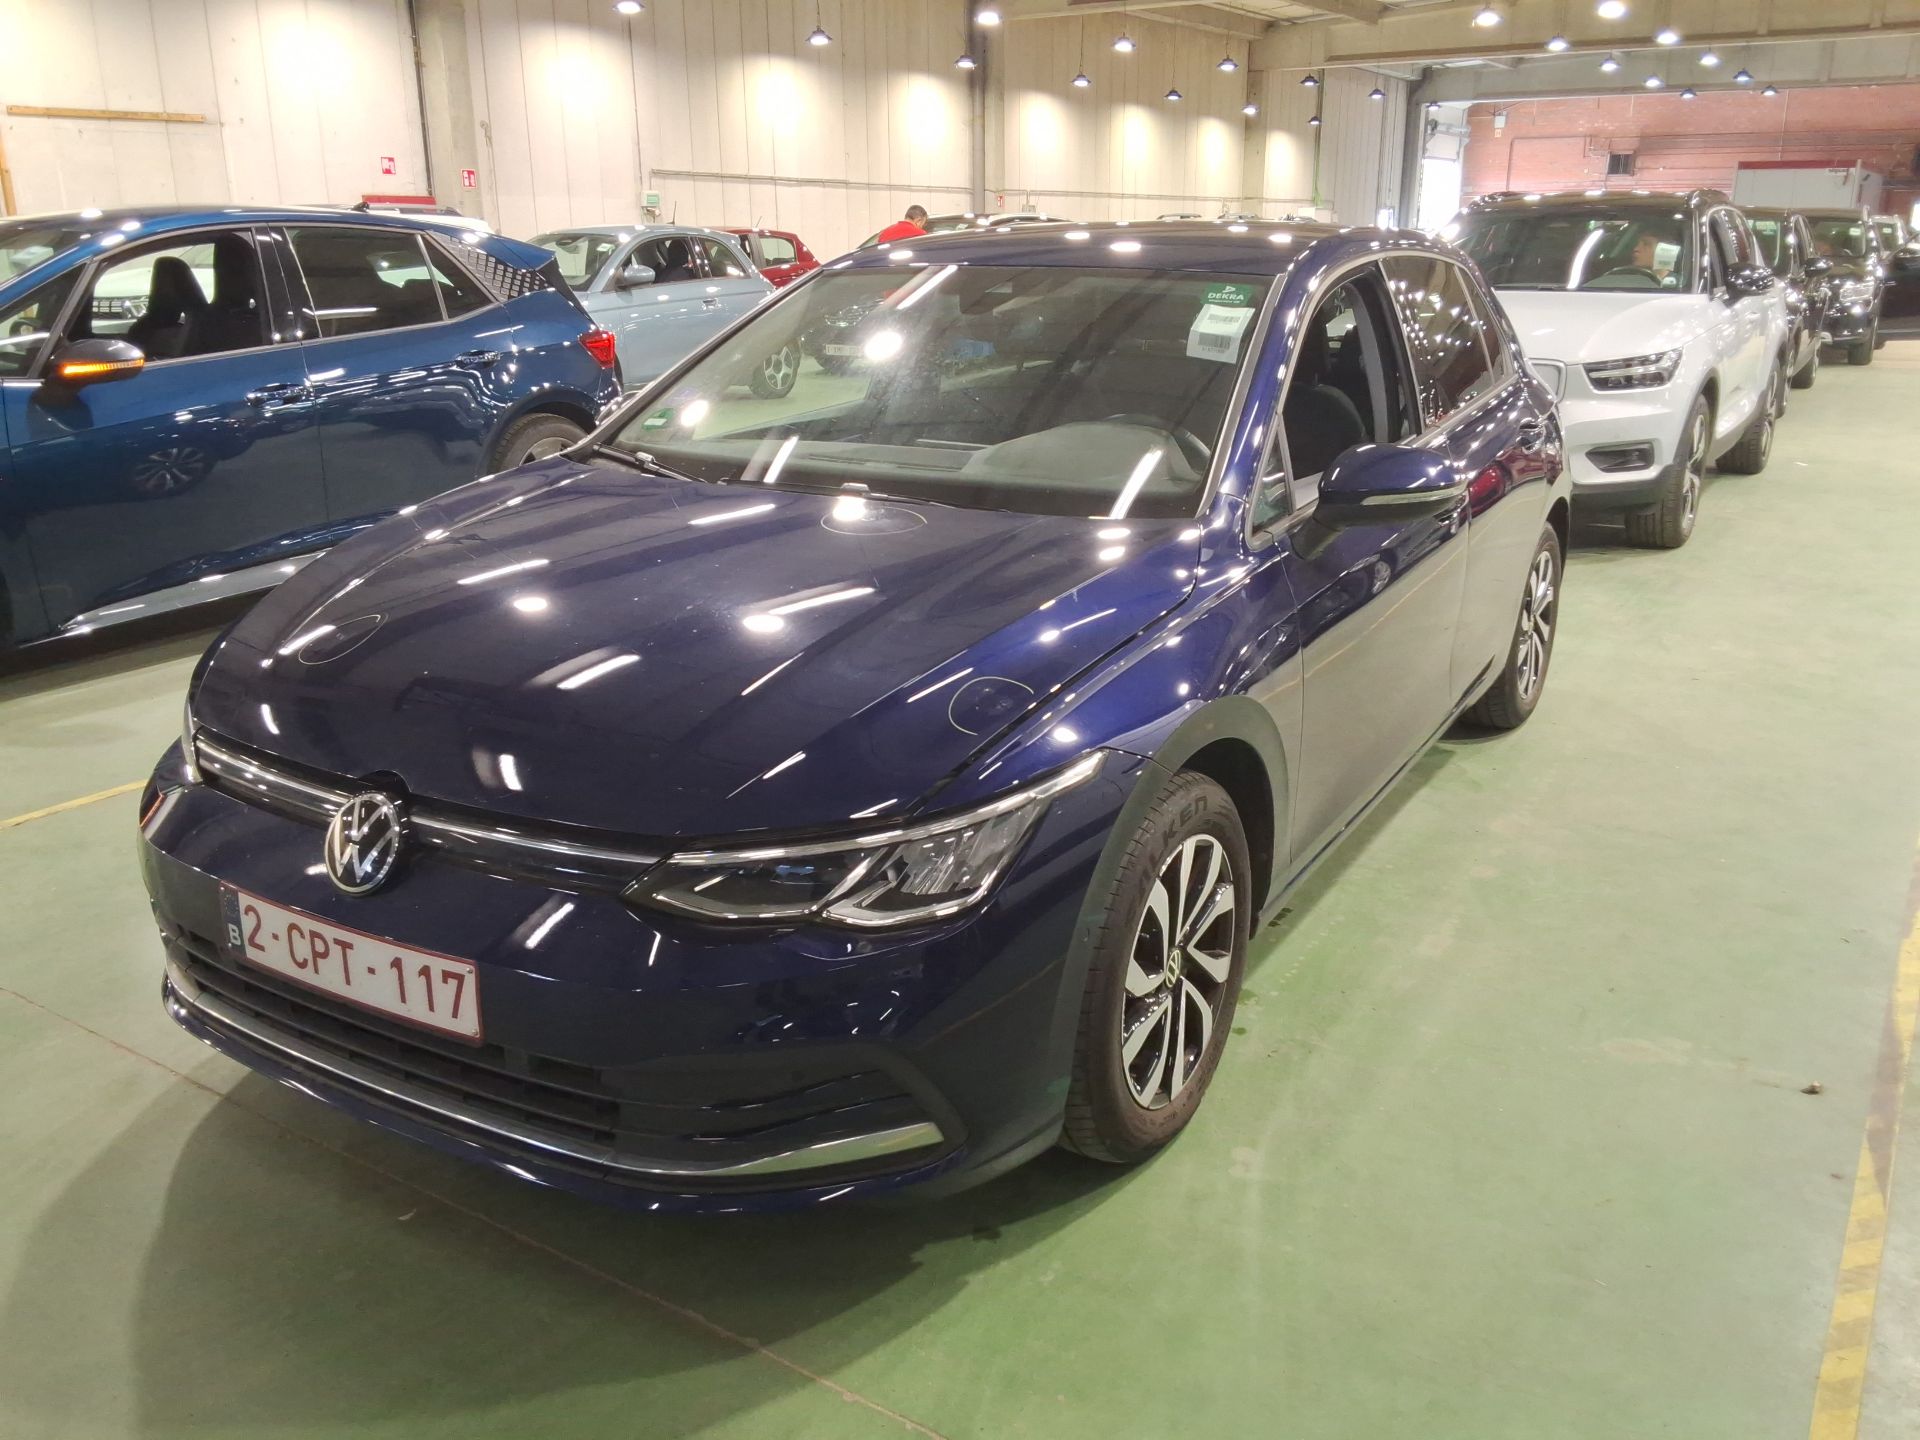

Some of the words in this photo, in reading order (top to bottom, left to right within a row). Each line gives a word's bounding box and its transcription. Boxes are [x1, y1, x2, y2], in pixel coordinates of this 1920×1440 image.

[1207, 292, 1245, 301] DEKRA
[228, 923, 241, 946] B
[244, 904, 466, 1019] 2-CPT-117
